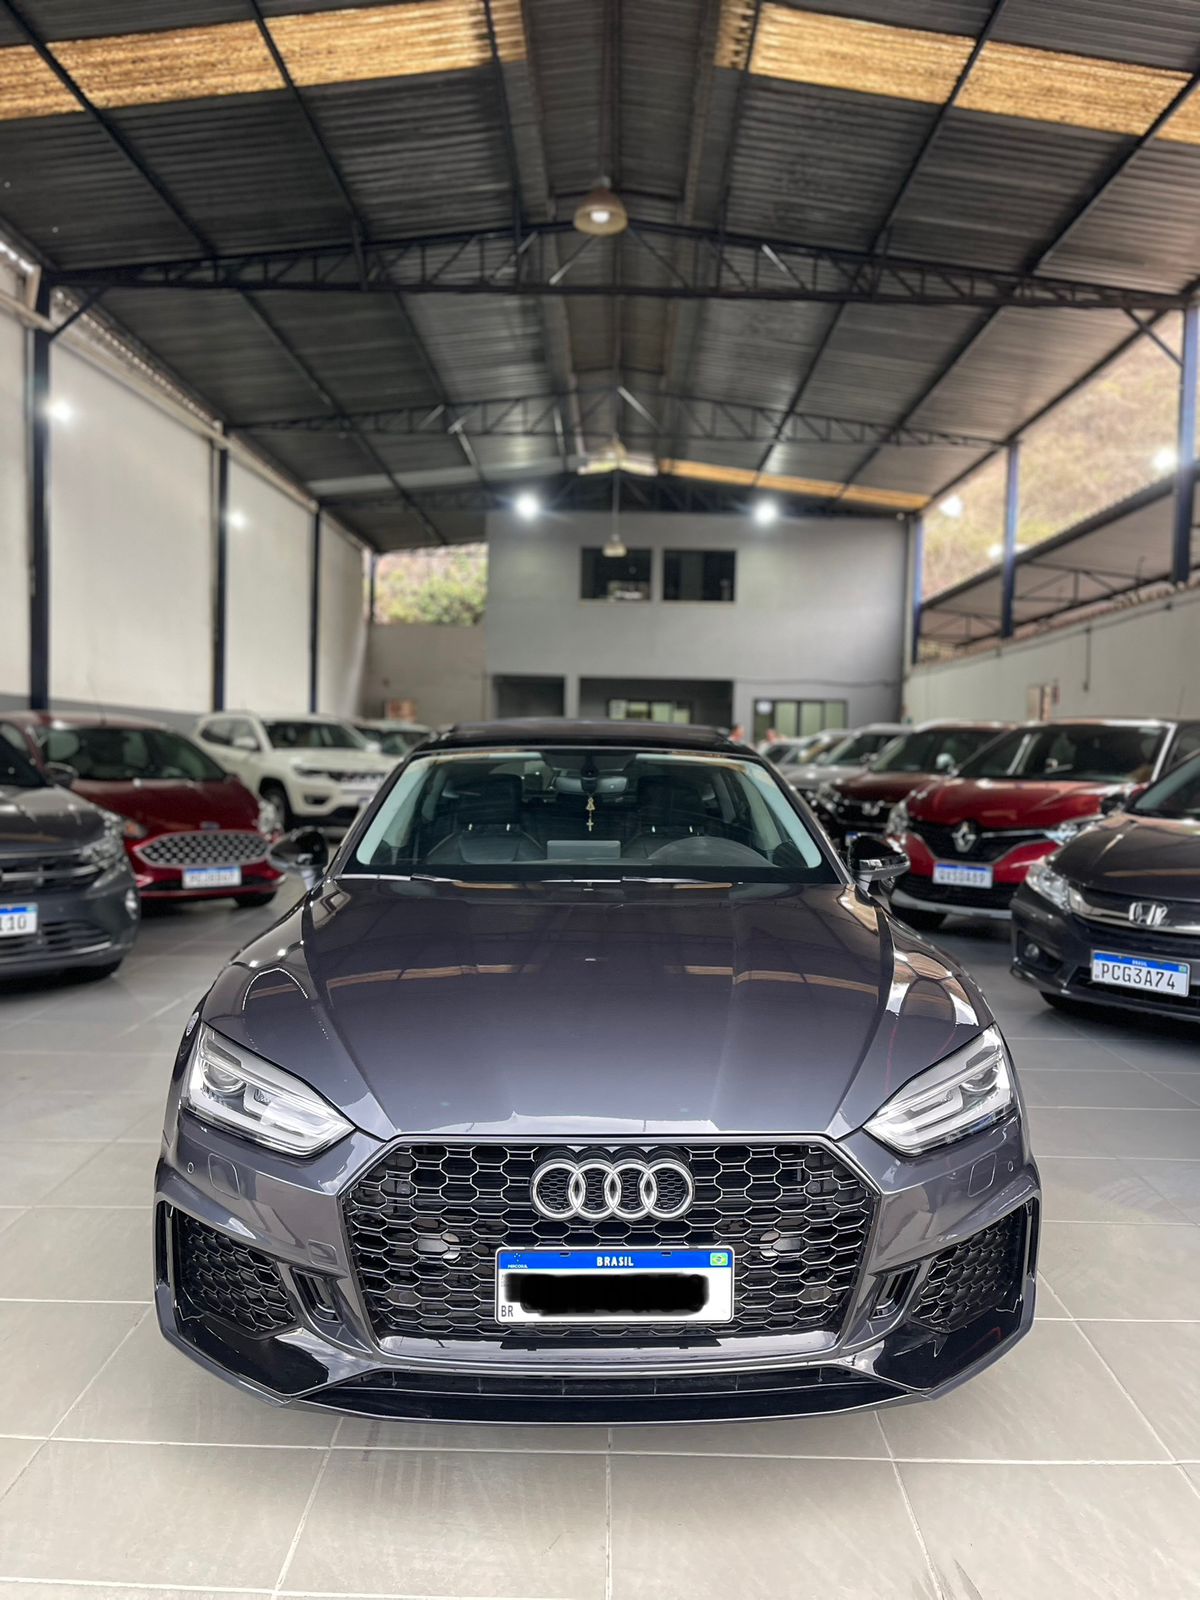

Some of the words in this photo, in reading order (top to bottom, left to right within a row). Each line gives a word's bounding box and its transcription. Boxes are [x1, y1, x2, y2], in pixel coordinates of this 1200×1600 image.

[0, 915, 27, 930] 10
[1101, 962, 1176, 990] PCG3A74
[596, 1256, 634, 1266] BRASIL
[501, 1305, 514, 1317] BR
